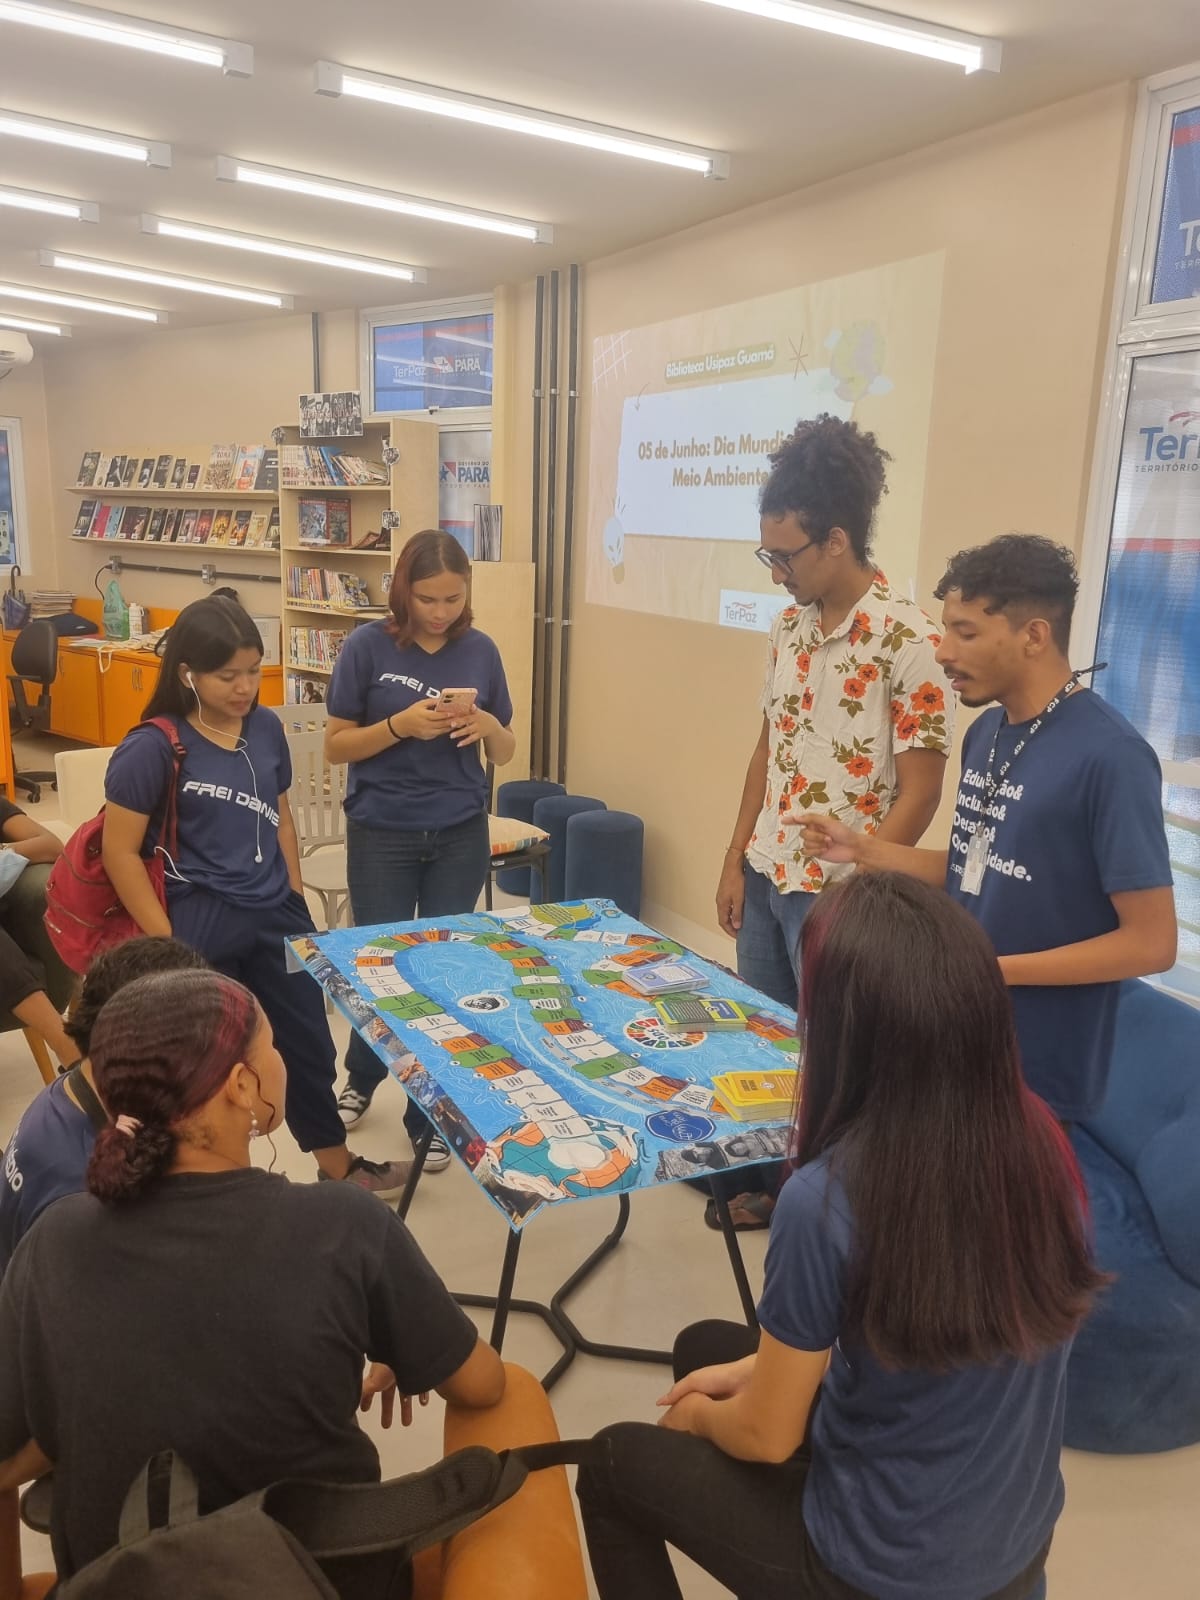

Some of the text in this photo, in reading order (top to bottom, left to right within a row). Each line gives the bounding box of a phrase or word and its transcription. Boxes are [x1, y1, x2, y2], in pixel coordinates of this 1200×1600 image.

[665, 361, 704, 378] Biblioteca
[705, 355, 736, 373] Usipaz
[638, 430, 784, 460] 05 de Junho: Dia Mundi
[1139, 426, 1200, 461] Ter
[672, 465, 769, 487] Meio Ambiente
[379, 673, 441, 699] FREI D
[182, 780, 233, 801] FREI
